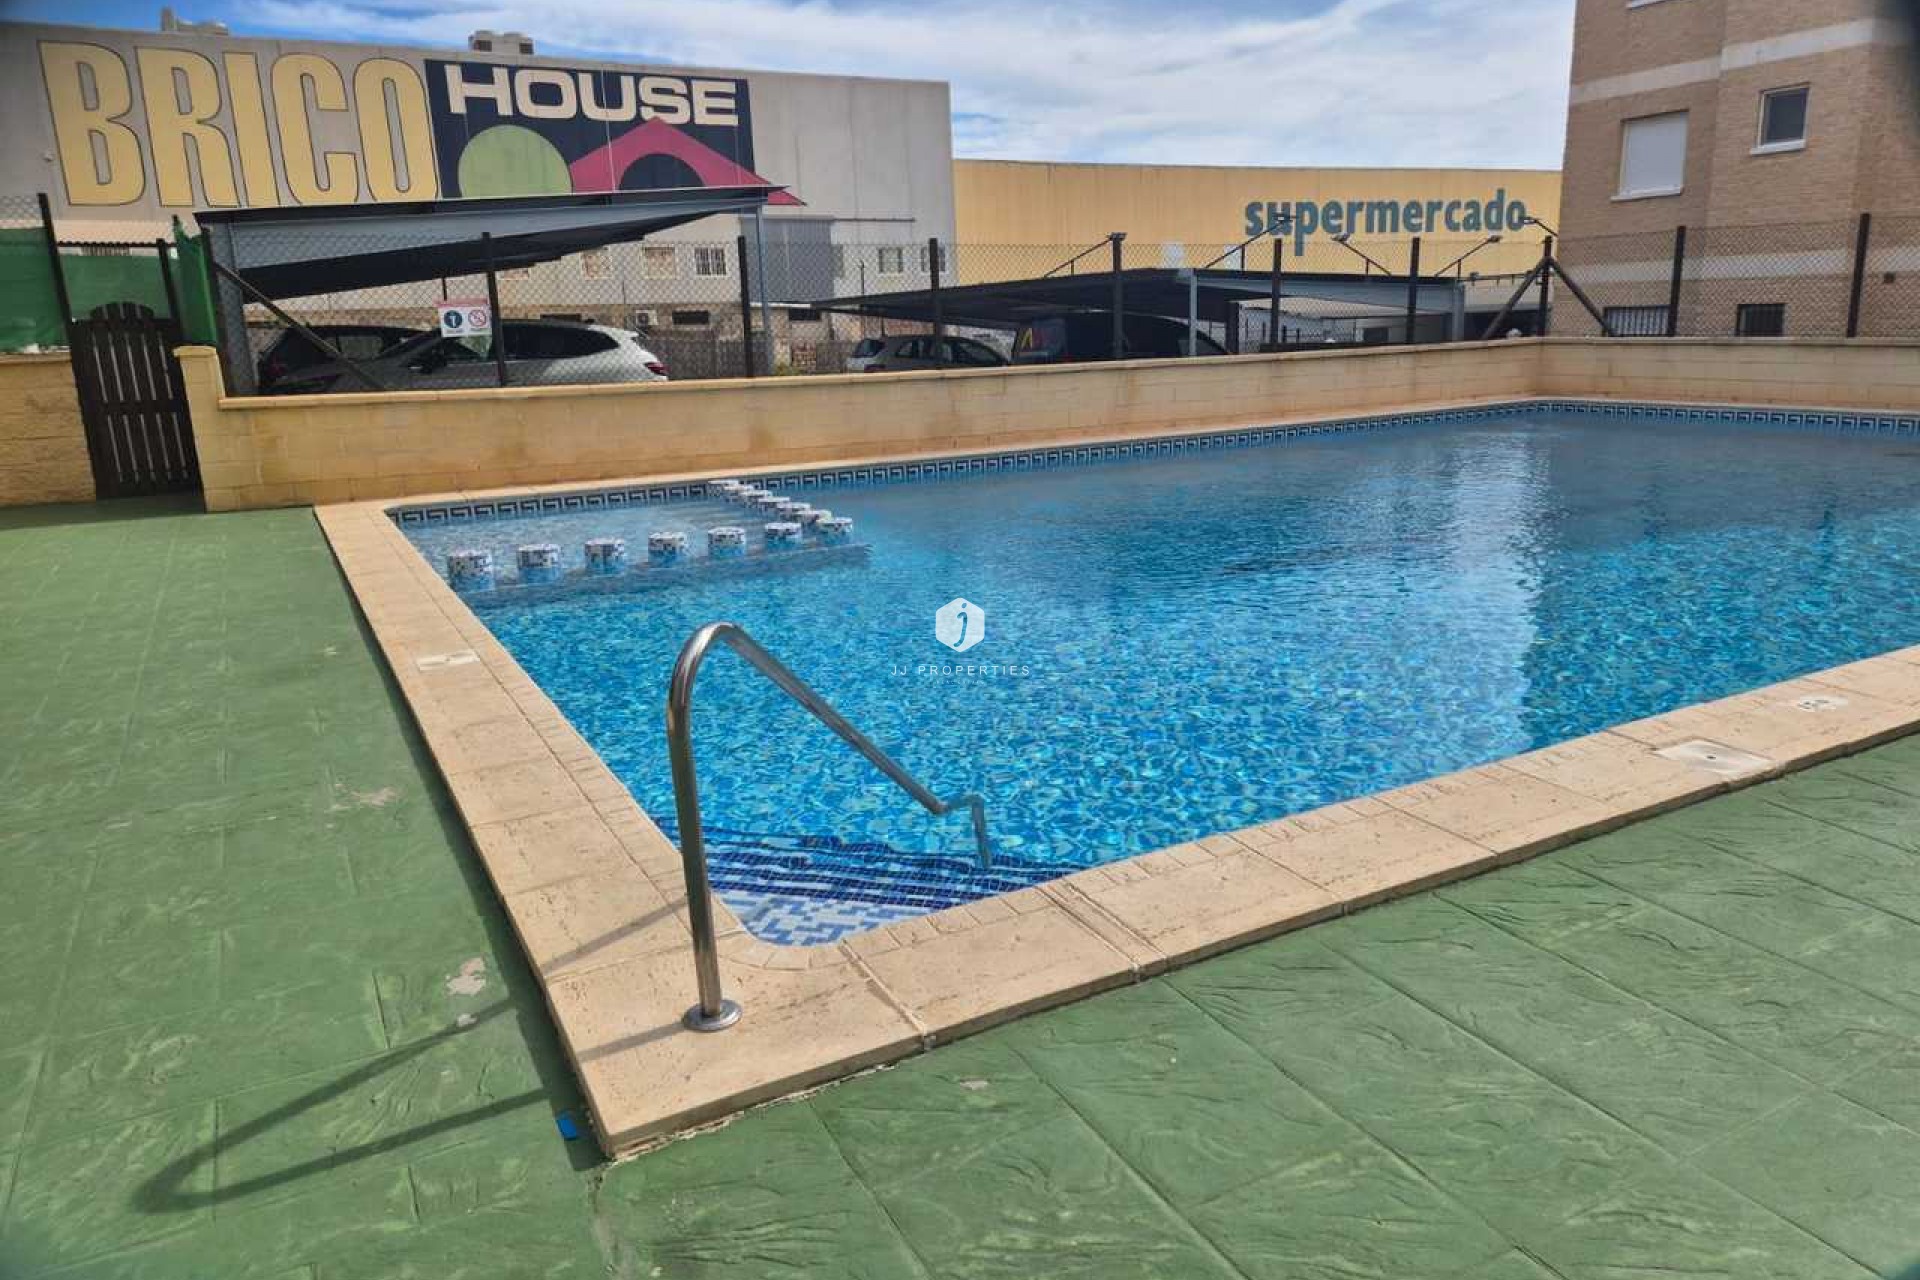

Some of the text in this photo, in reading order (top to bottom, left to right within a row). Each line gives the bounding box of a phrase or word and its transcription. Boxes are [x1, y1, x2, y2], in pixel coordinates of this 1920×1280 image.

[38, 40, 740, 207] BRICO HOUSE
[1244, 187, 1526, 256] supermercado
